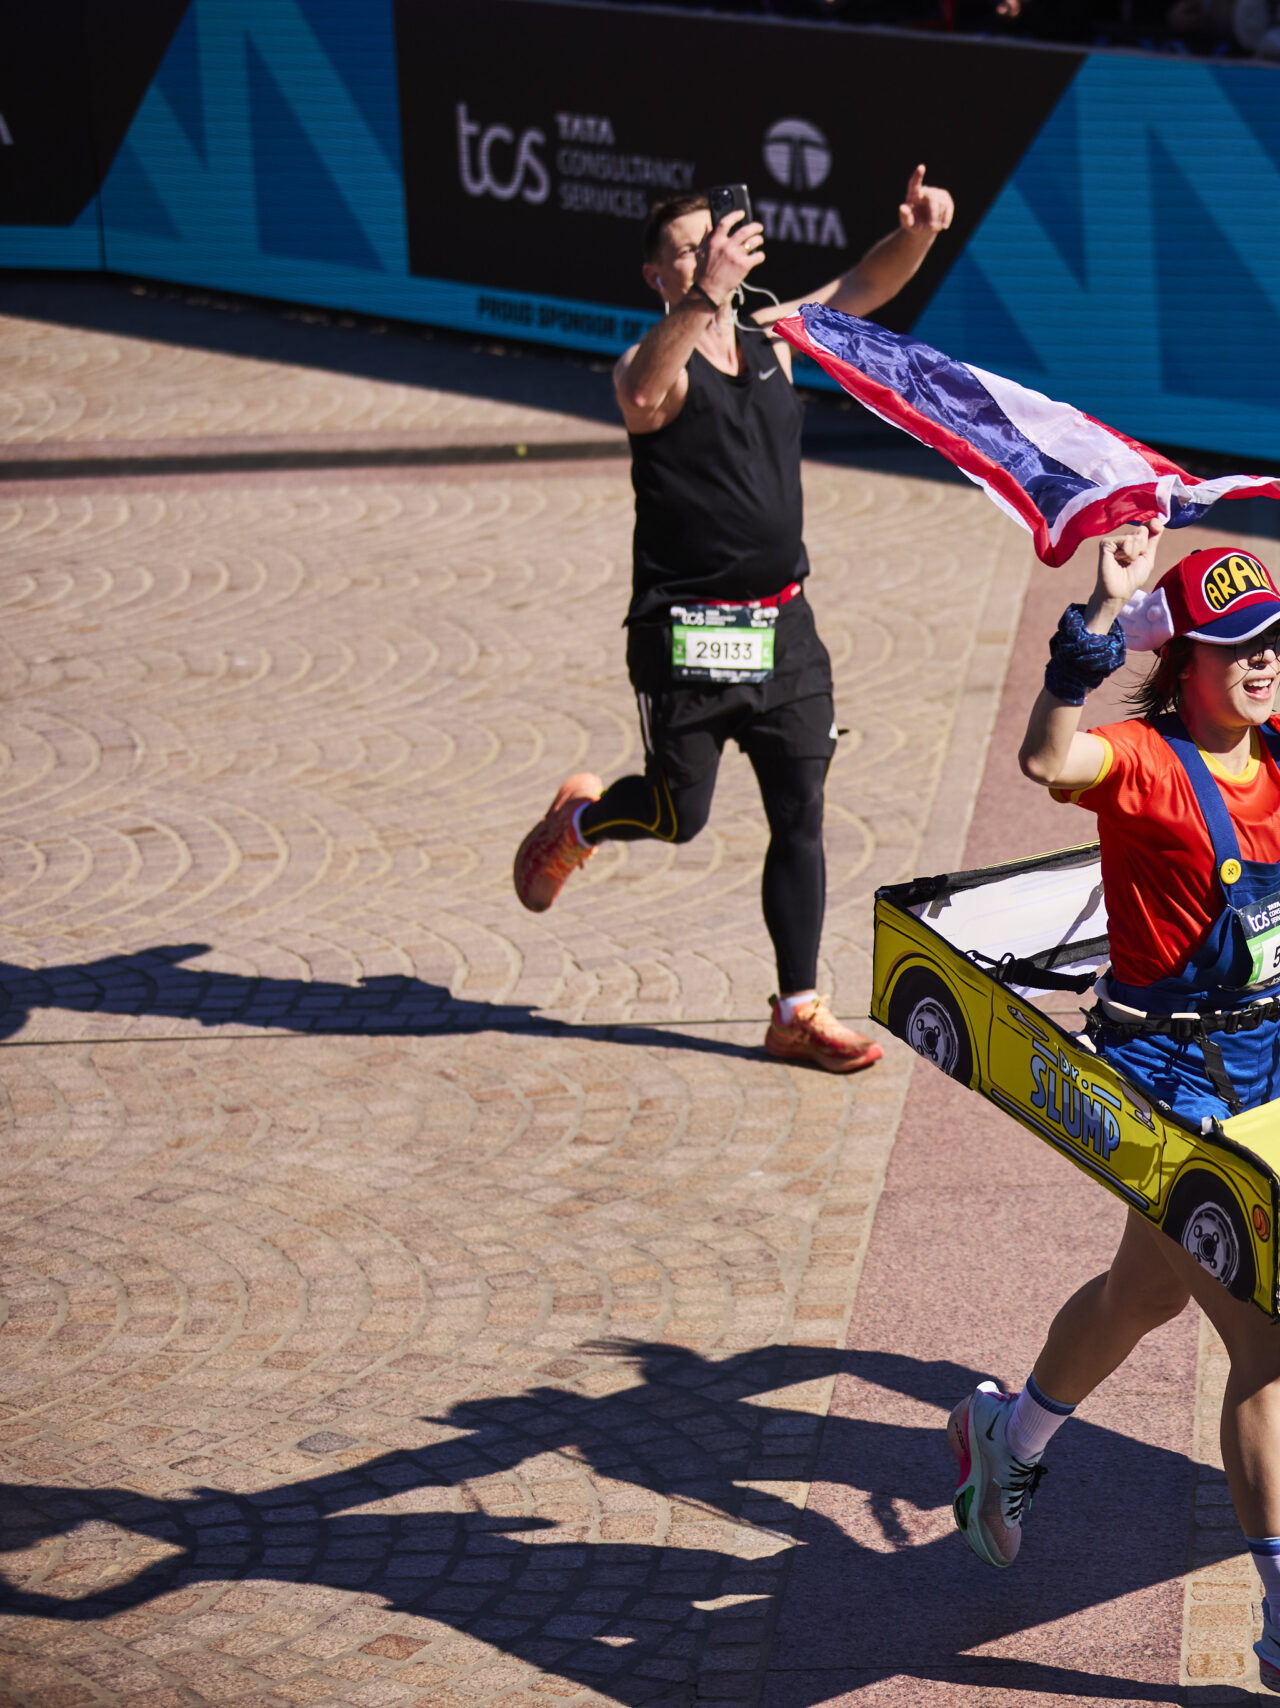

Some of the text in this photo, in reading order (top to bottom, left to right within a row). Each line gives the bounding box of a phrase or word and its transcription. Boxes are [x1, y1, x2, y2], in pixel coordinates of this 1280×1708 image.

[556, 113, 615, 145] TATA
[456, 102, 550, 204] tcs
[557, 149, 696, 190] CONSULTANCY
[559, 182, 649, 220] SERVICES
[756, 200, 847, 249] TATA
[696, 641, 752, 660] 29133
[1246, 911, 1270, 932] tcs
[1030, 1054, 1121, 1162] SLUMP
